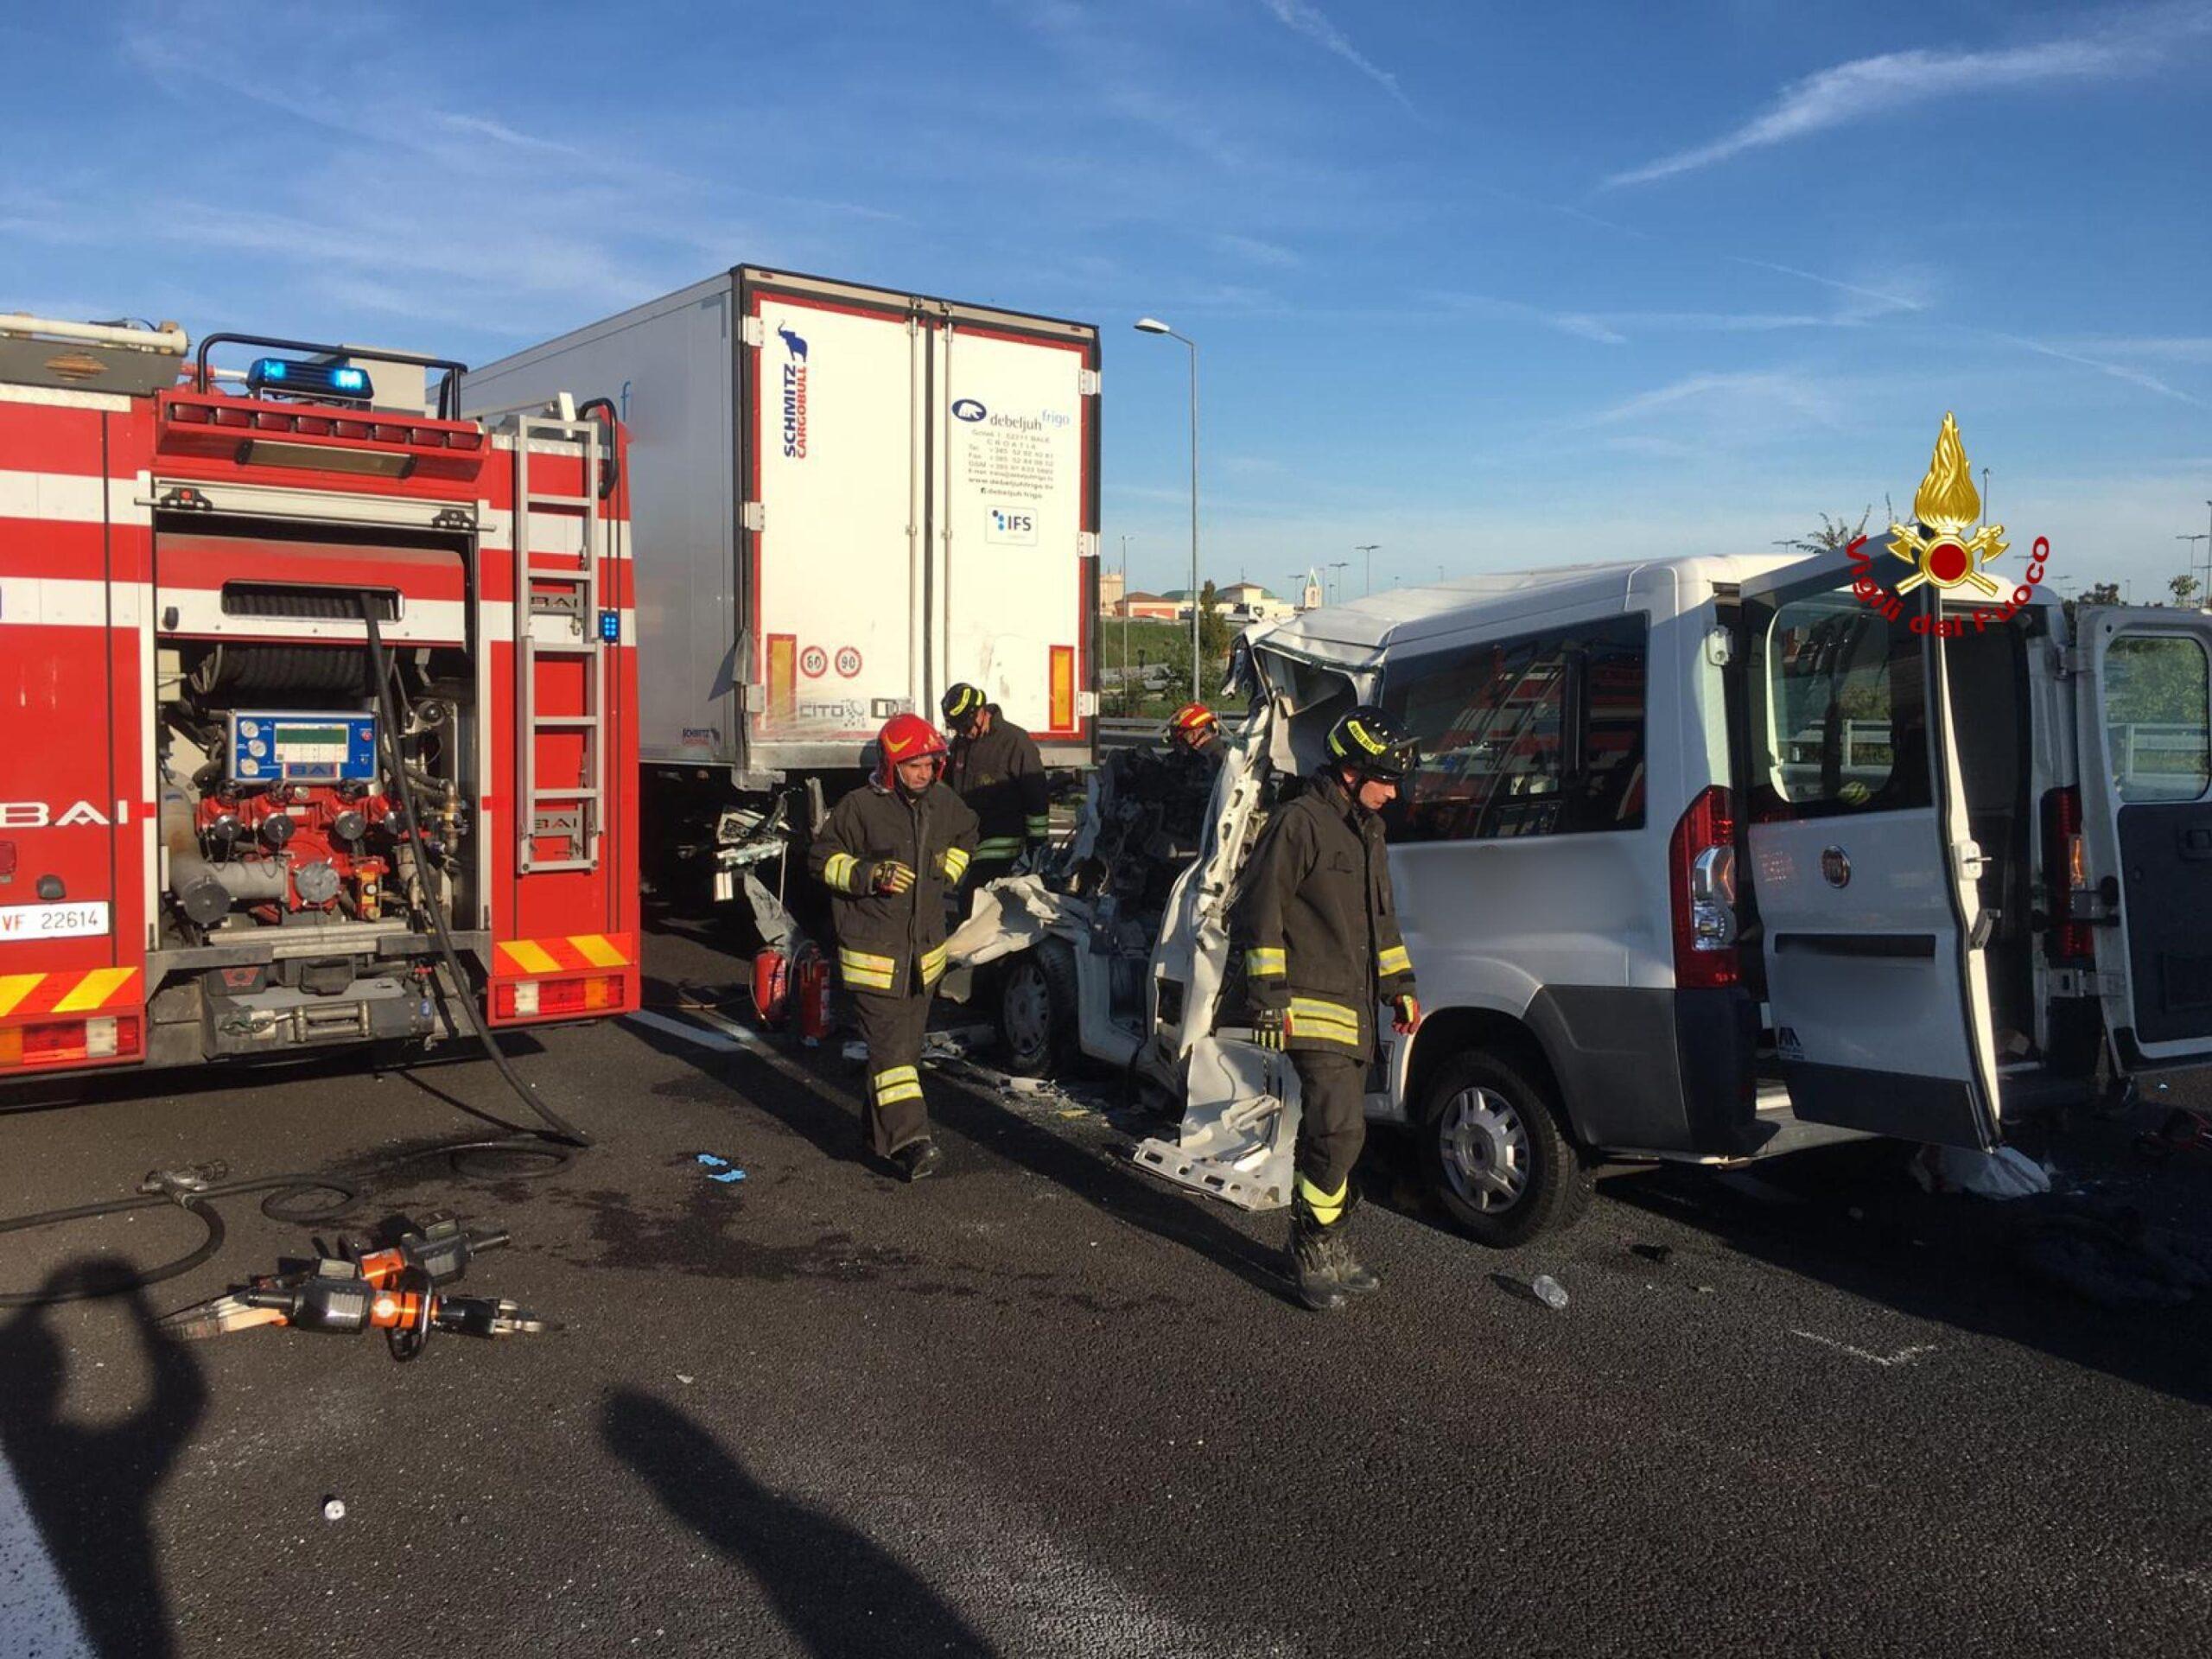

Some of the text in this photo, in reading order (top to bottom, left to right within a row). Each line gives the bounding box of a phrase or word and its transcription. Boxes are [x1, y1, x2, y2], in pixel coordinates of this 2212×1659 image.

[784, 364, 796, 458] SCHMITZ
[797, 365, 807, 459] CARGOBULL
[990, 410, 1070, 432] debeljuh frigo
[1007, 516, 1032, 531] IFS
[531, 596, 577, 608] BAI
[799, 704, 843, 717] CITO
[289, 764, 335, 777] BAI
[0, 799, 128, 828] BAI
[534, 817, 577, 829] BAI
[3, 910, 98, 931] VF 22614
